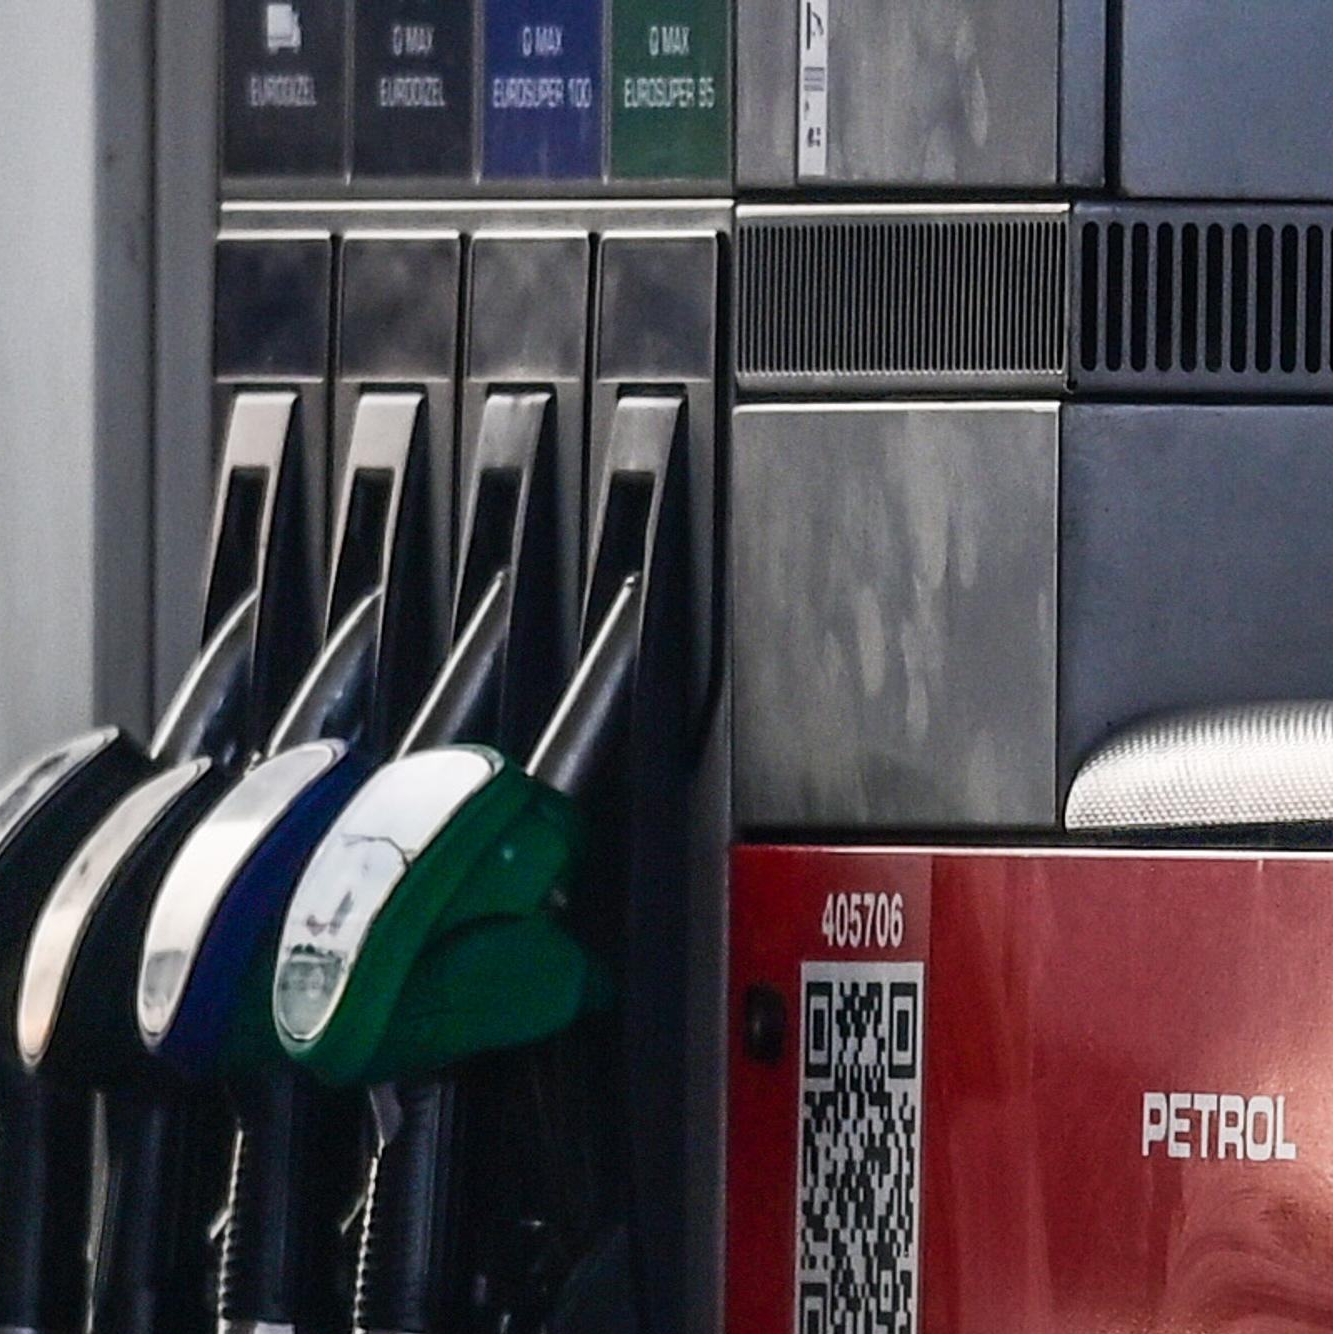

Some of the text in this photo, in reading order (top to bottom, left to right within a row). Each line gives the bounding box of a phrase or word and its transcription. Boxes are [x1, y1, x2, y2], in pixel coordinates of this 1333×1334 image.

[405, 24, 434, 54] MAX
[535, 25, 563, 55] MAX
[661, 25, 690, 54] MAX
[492, 77, 592, 108] EUROSUPER 100
[624, 77, 715, 108] EUROSUPER 95
[821, 892, 903, 948] 405706
[1142, 1092, 1296, 1161] PETROL
